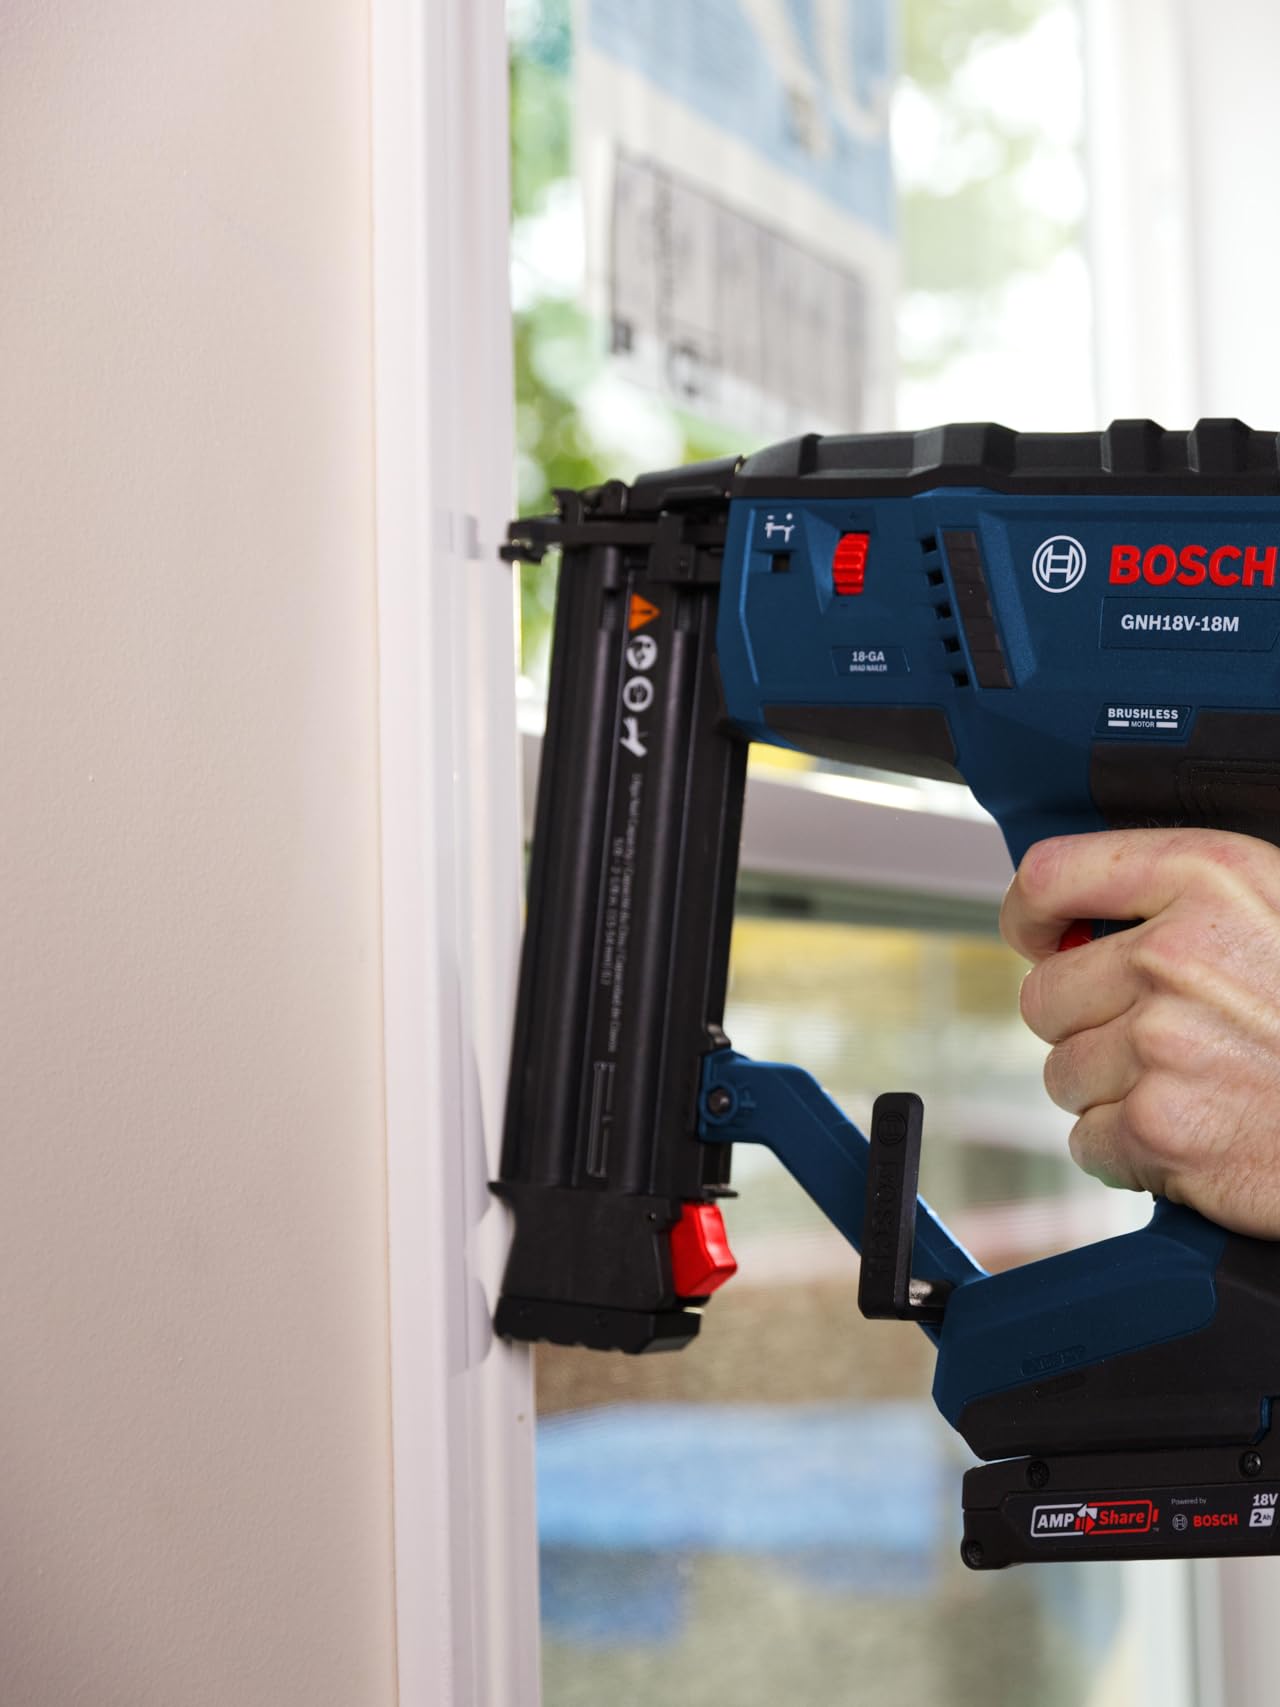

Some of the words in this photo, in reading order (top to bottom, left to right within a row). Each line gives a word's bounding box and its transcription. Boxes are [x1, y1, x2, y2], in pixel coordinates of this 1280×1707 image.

[1108, 544, 1278, 587] BOSCH
[1120, 613, 1240, 632] GNH18V-18M
[852, 650, 886, 662] 18-GA
[1107, 708, 1179, 719] BRUSHLESS
[1130, 720, 1155, 728] MOTOR
[1252, 1493, 1279, 1506] 18V
[1037, 1513, 1075, 1528] AMP
[1099, 1509, 1145, 1525] Share
[1193, 1514, 1239, 1528] BOSCH
